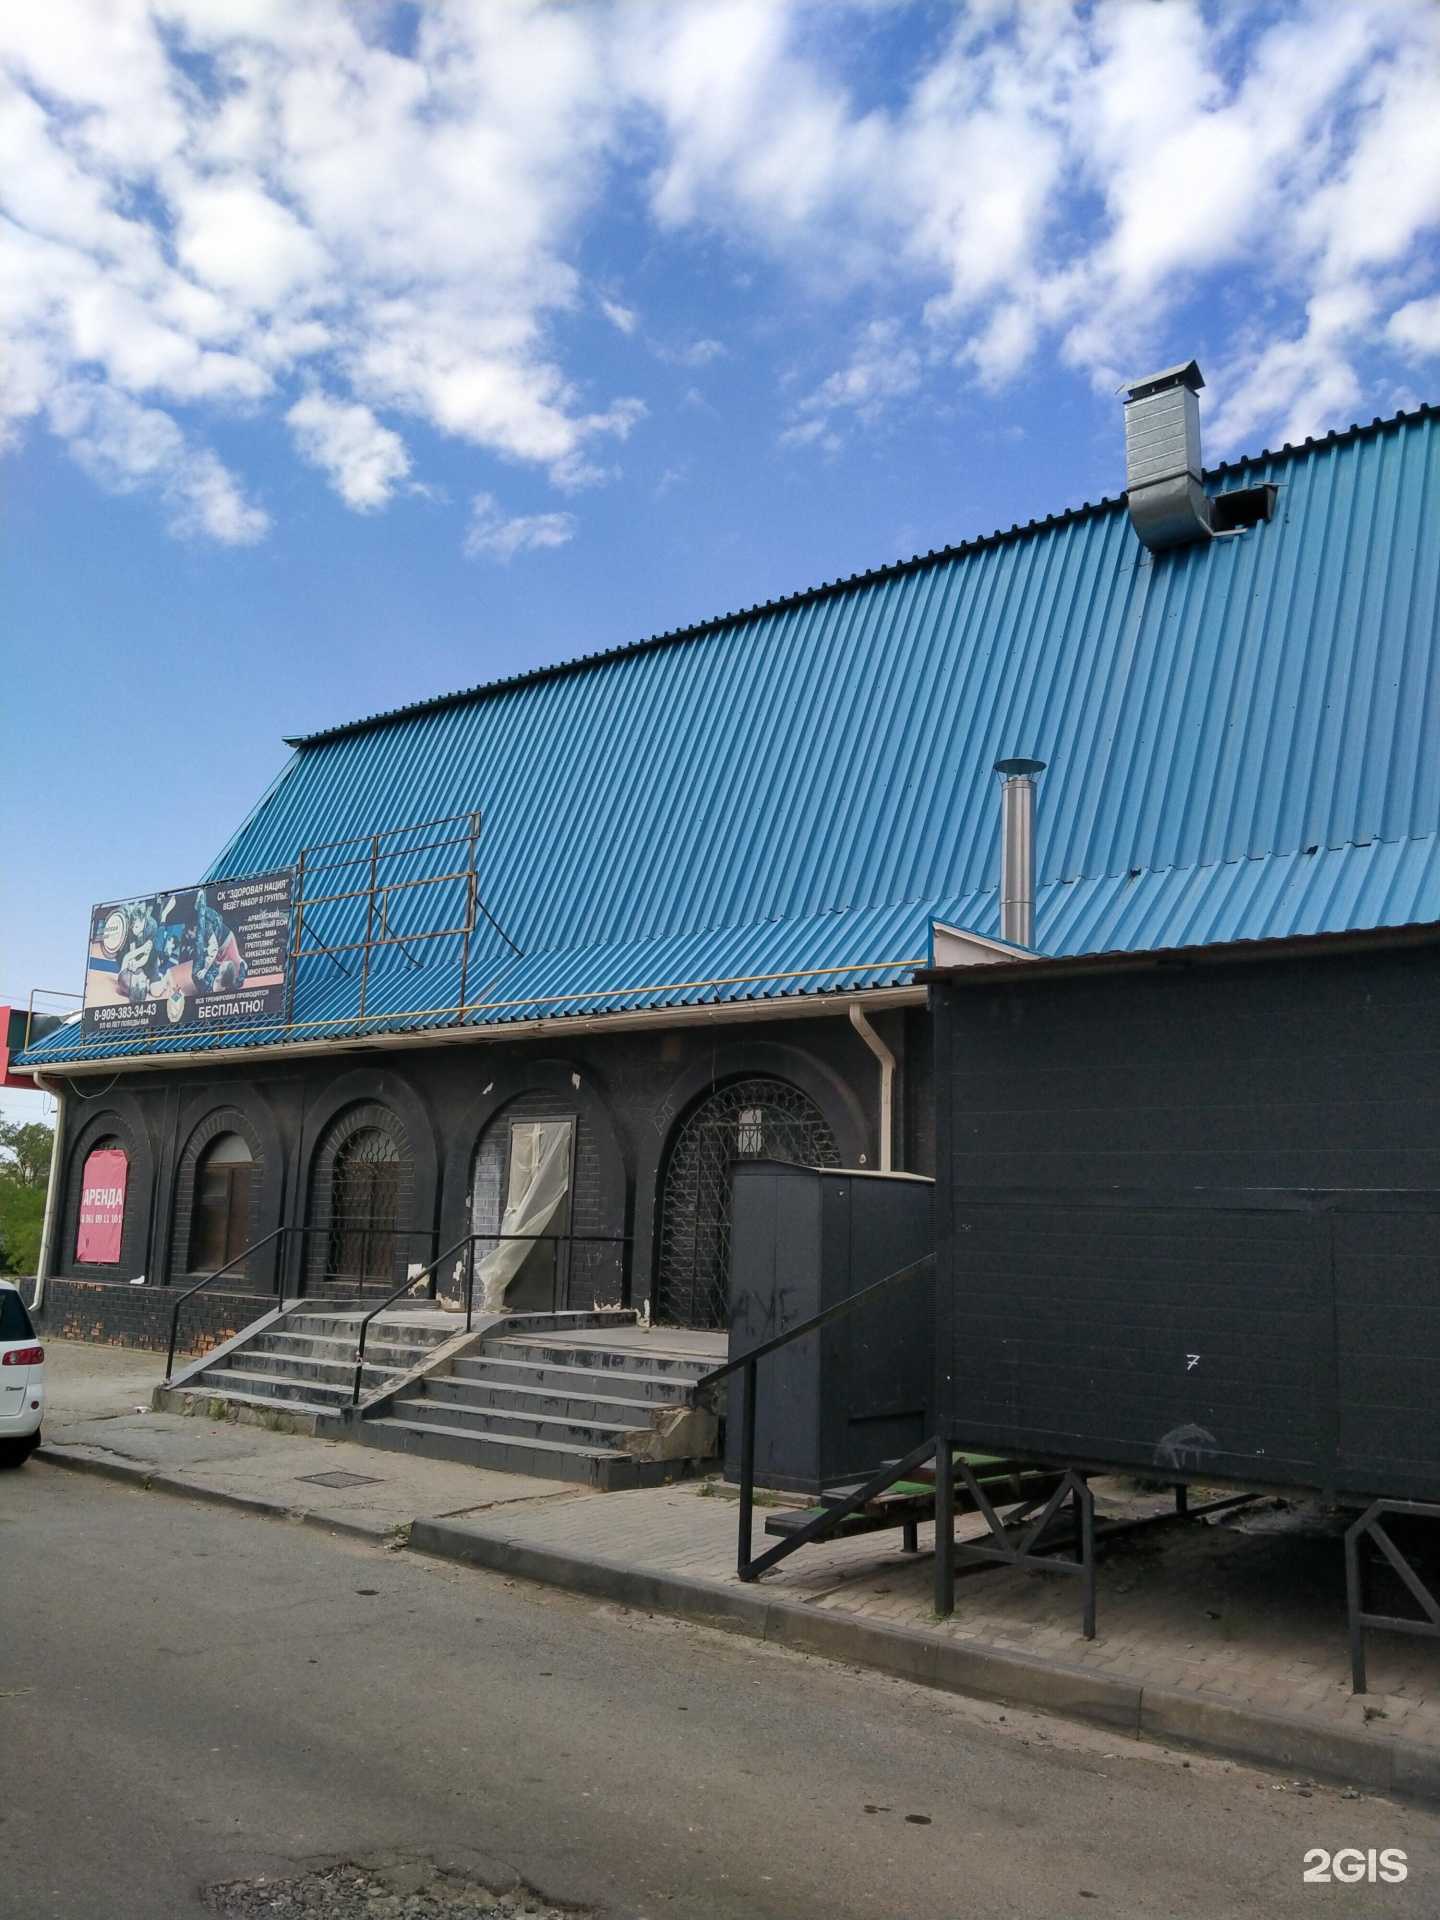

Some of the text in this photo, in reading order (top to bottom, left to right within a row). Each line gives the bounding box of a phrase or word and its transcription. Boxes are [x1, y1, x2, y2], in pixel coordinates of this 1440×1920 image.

[217, 890, 226, 901] СК
[240, 896, 258, 907] НАБОР
[94, 1003, 156, 1021] 8-909-383-34-43
[198, 1000, 264, 1019] БЕСПЛАТНО!
[82, 1188, 123, 1209] АРЕНДА
[1186, 1354, 1201, 1371] 7
